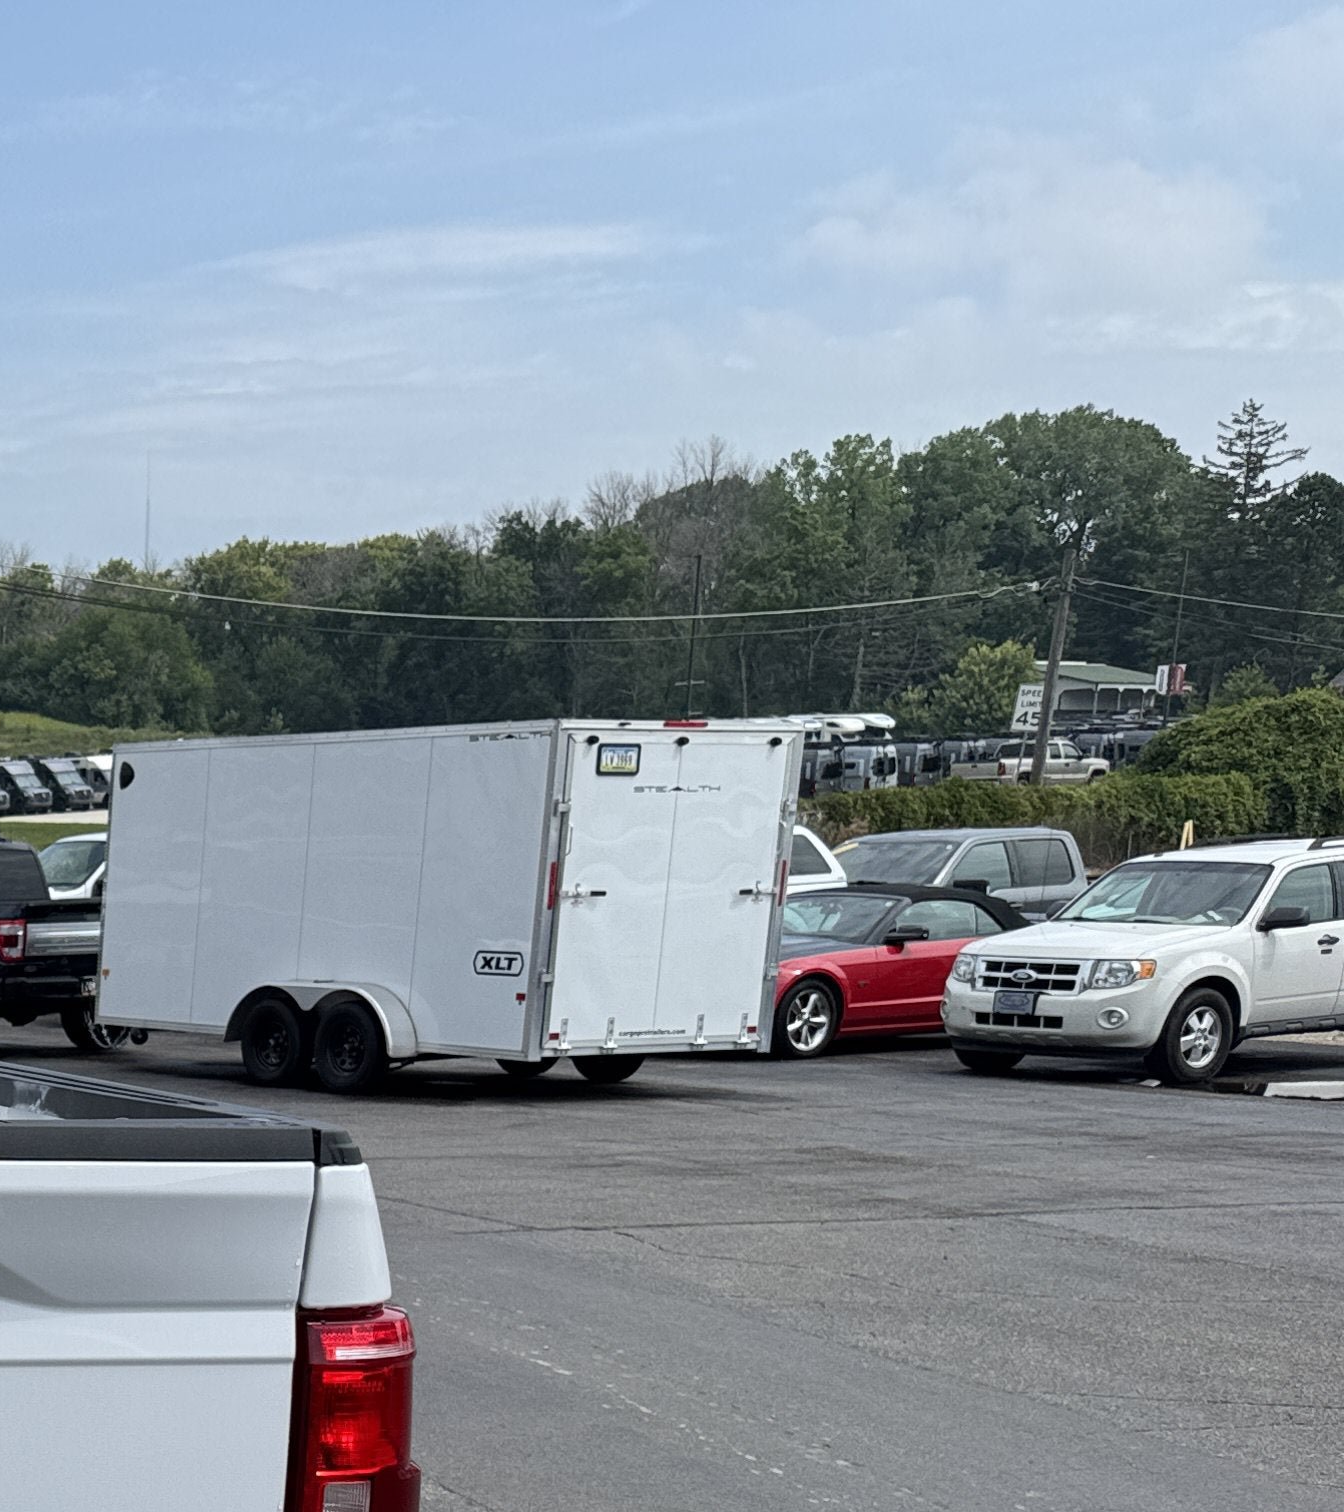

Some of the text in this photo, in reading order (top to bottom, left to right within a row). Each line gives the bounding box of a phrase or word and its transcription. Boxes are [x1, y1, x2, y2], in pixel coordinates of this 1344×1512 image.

[1021, 688, 1042, 698] SPEE
[1015, 710, 1040, 726] 45
[633, 784, 721, 793] STEALTH
[480, 956, 518, 971] XLT
